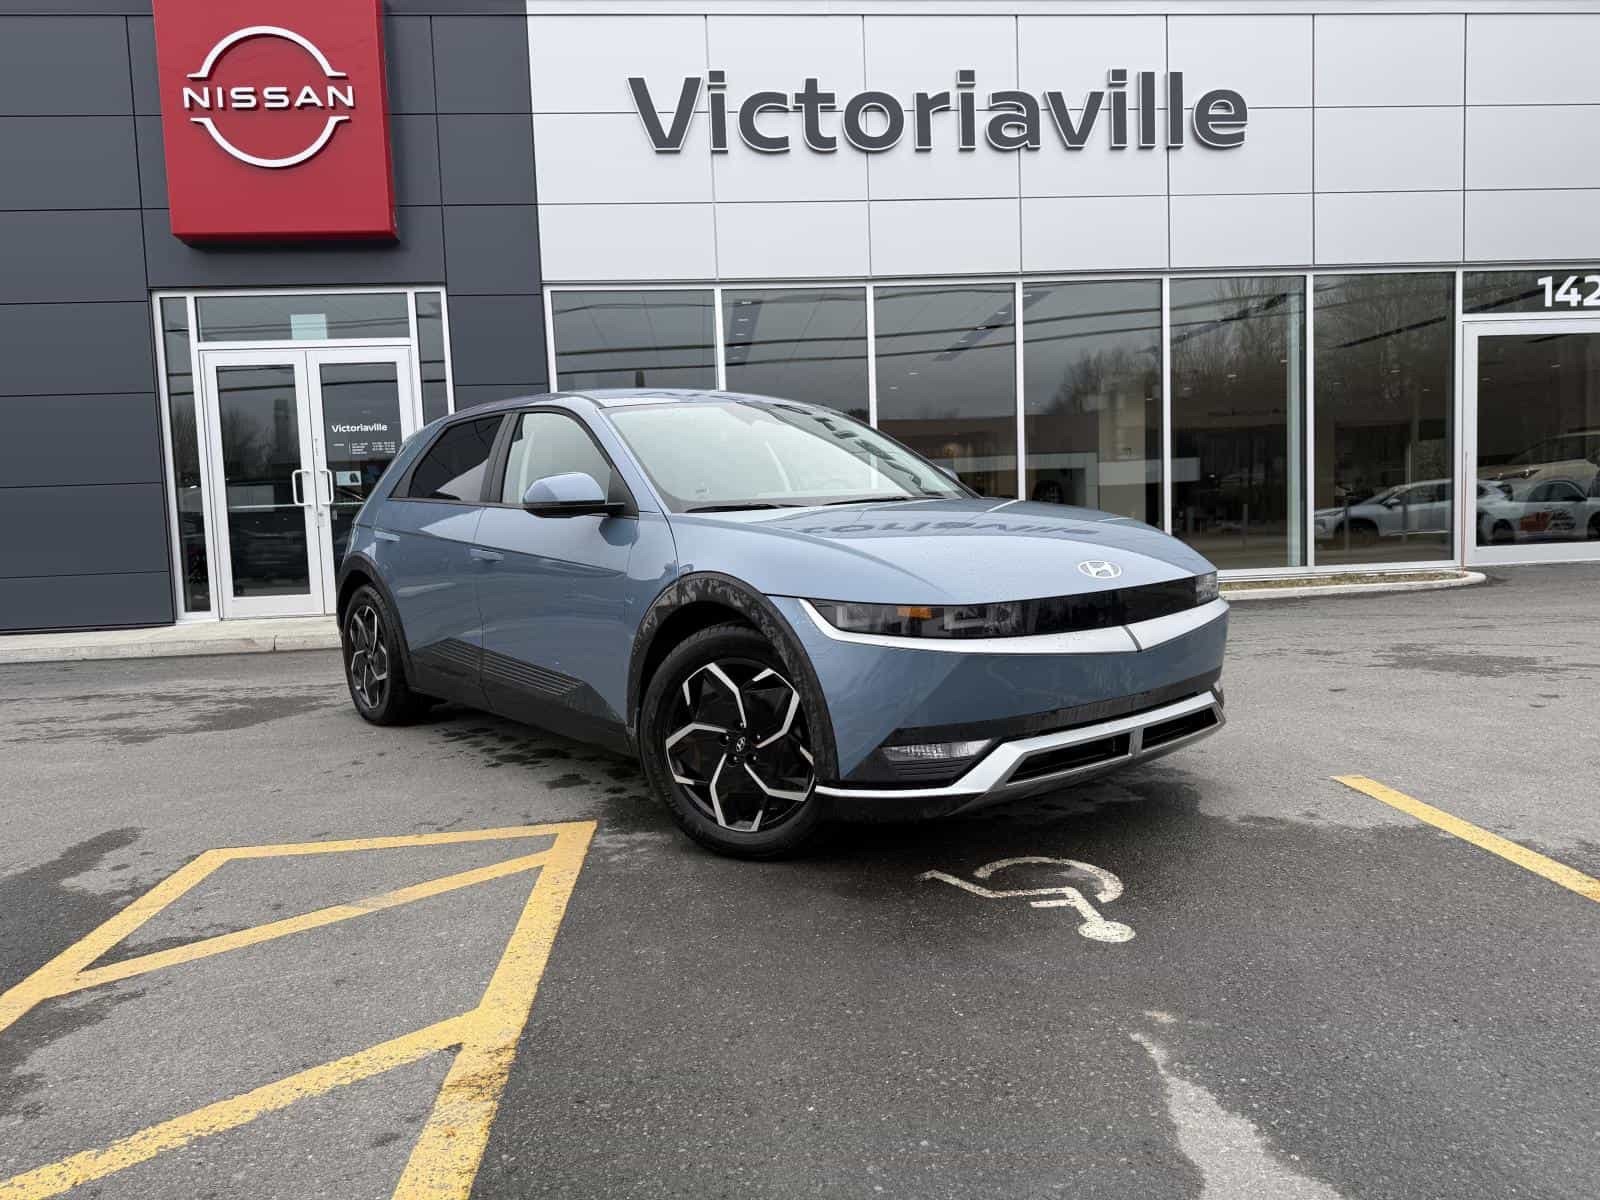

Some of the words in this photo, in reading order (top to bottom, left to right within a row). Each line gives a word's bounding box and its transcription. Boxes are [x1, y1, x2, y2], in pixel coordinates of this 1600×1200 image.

[182, 86, 355, 109] NISSAN
[627, 69, 1248, 152] Victoriaville
[331, 423, 388, 432] Victoriaville
